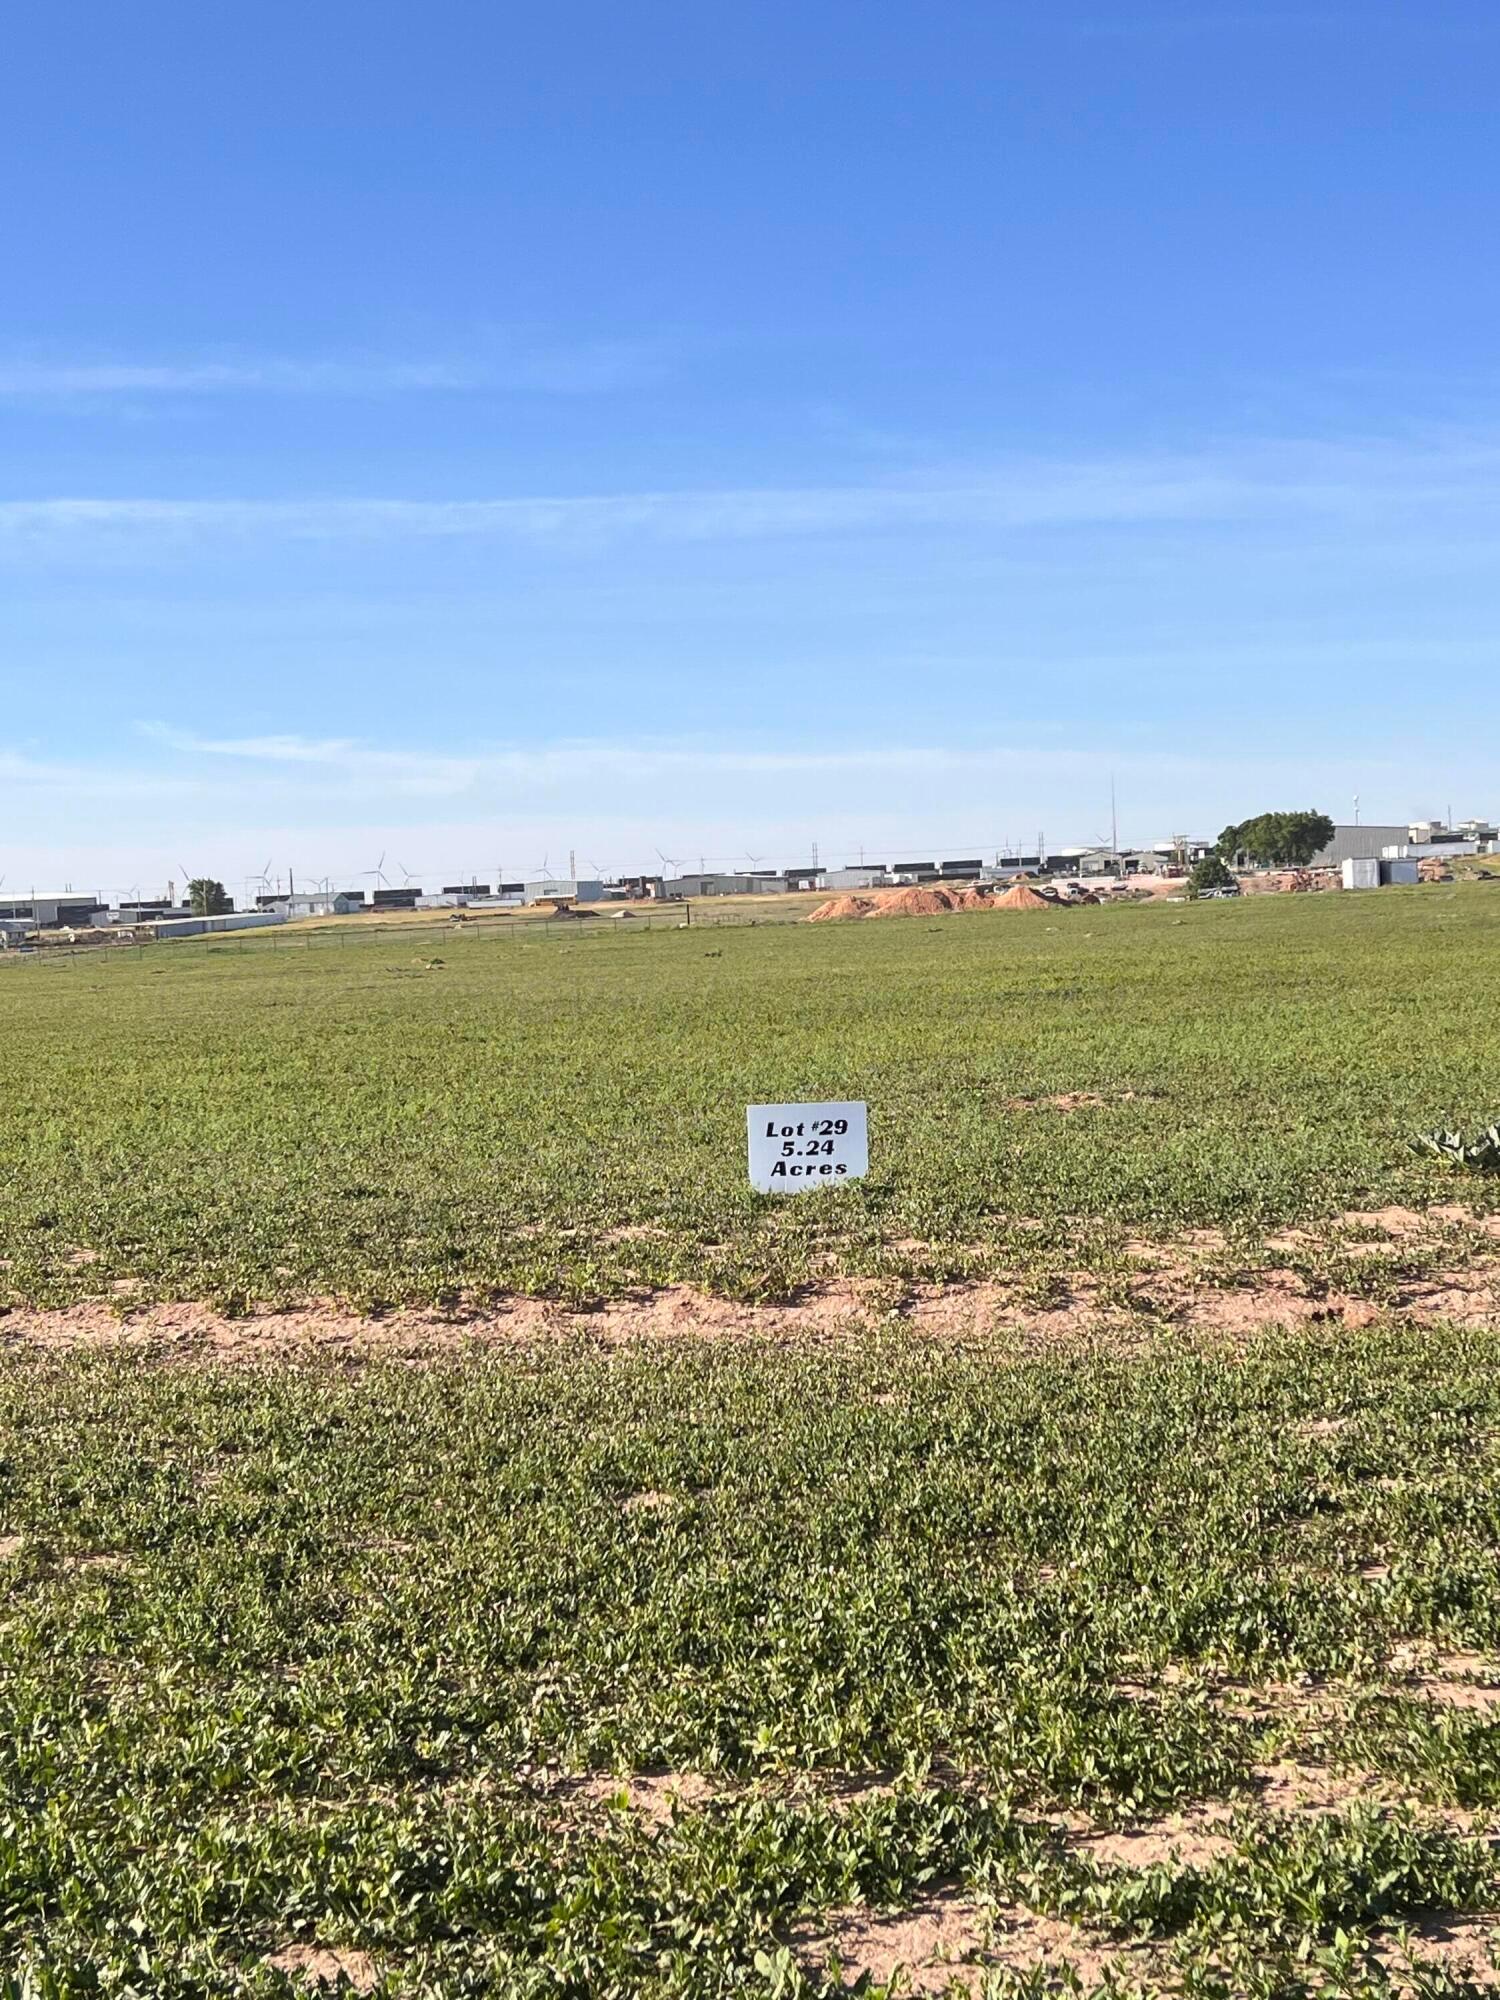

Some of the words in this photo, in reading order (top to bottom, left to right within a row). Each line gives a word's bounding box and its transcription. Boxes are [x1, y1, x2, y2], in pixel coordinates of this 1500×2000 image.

[766, 1121, 804, 1138] Lot
[811, 1119, 848, 1136] #29
[780, 1139, 834, 1157] 5.24
[770, 1161, 848, 1177] Acres
